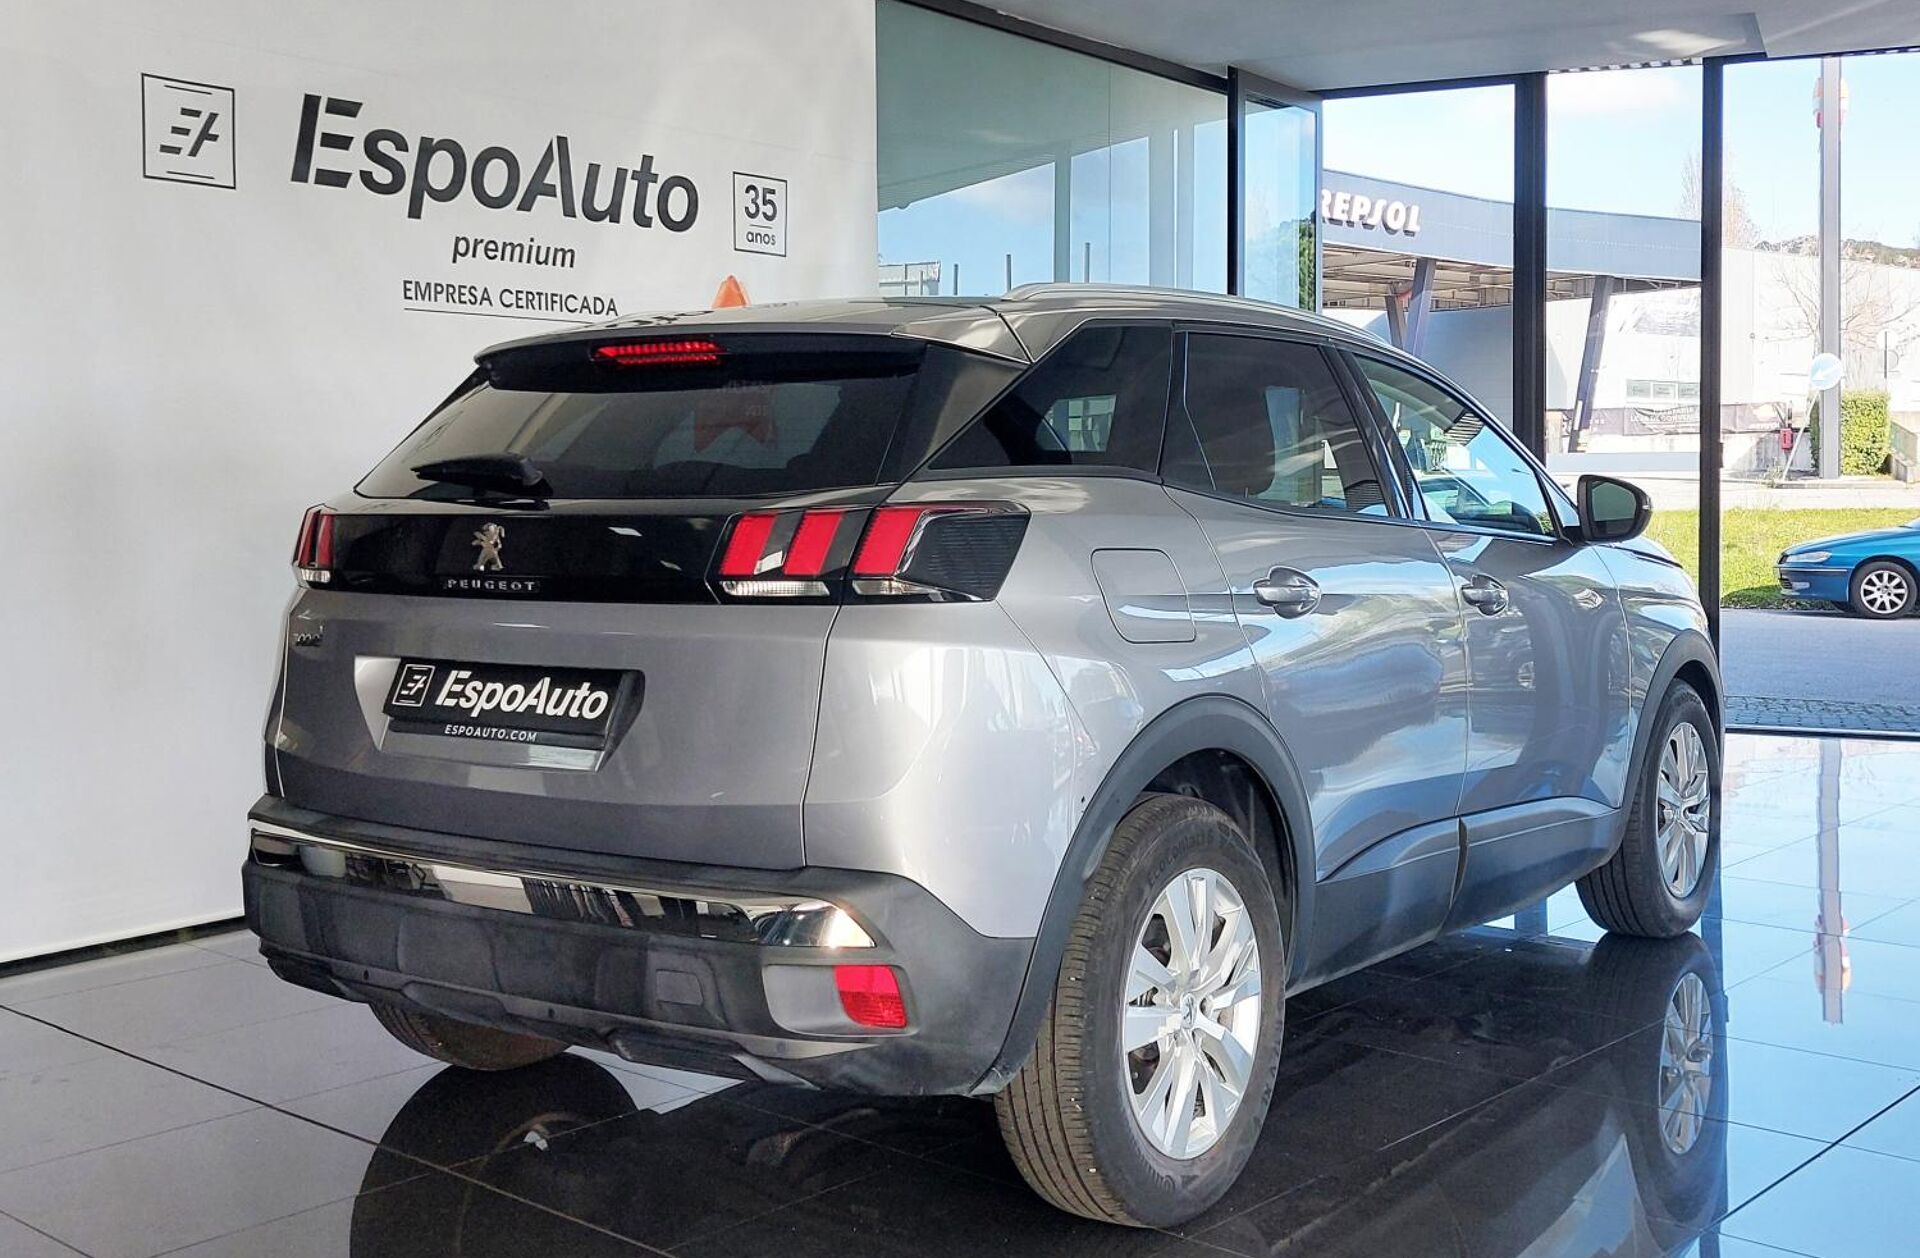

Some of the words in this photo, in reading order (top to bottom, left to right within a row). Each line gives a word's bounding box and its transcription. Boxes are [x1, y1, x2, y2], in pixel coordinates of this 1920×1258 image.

[290, 92, 700, 233] EspoAuto
[744, 184, 778, 222] 35
[451, 234, 577, 269] premium
[745, 230, 777, 246] anos
[401, 279, 494, 308] EMPRESA
[498, 288, 620, 317] CERTIFICADA
[446, 578, 536, 591] PEUGEOT
[434, 669, 610, 720] EspoAuto
[443, 723, 538, 743] ESPOAUTO.COM
